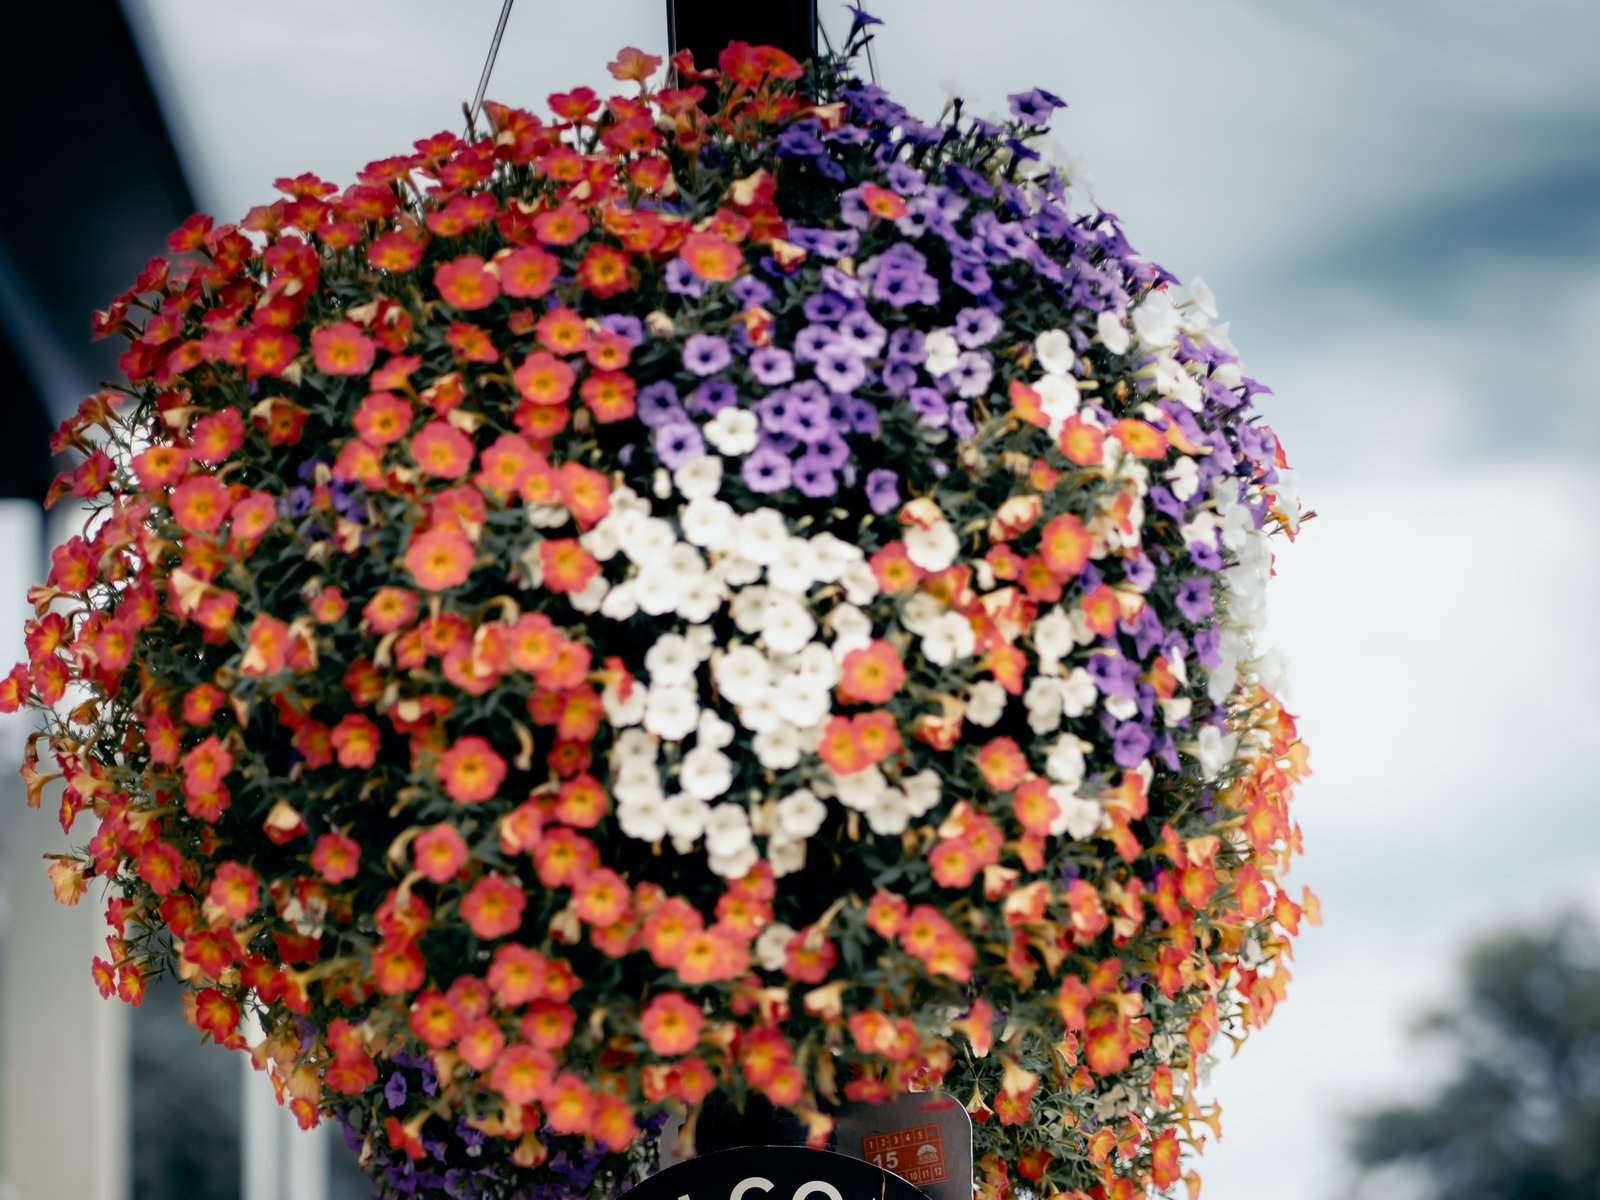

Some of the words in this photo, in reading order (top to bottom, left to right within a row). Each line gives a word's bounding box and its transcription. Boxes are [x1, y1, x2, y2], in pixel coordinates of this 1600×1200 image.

[868, 1140, 874, 1149] 1
[880, 1138, 887, 1147] 2
[893, 1136, 899, 1144] 3
[905, 1134, 911, 1142] 4
[917, 1132, 923, 1140] 5
[872, 1151, 899, 1169] 15
[909, 1171, 918, 1181] 10
[922, 1169, 930, 1178] 11
[934, 1167, 942, 1176] 12
